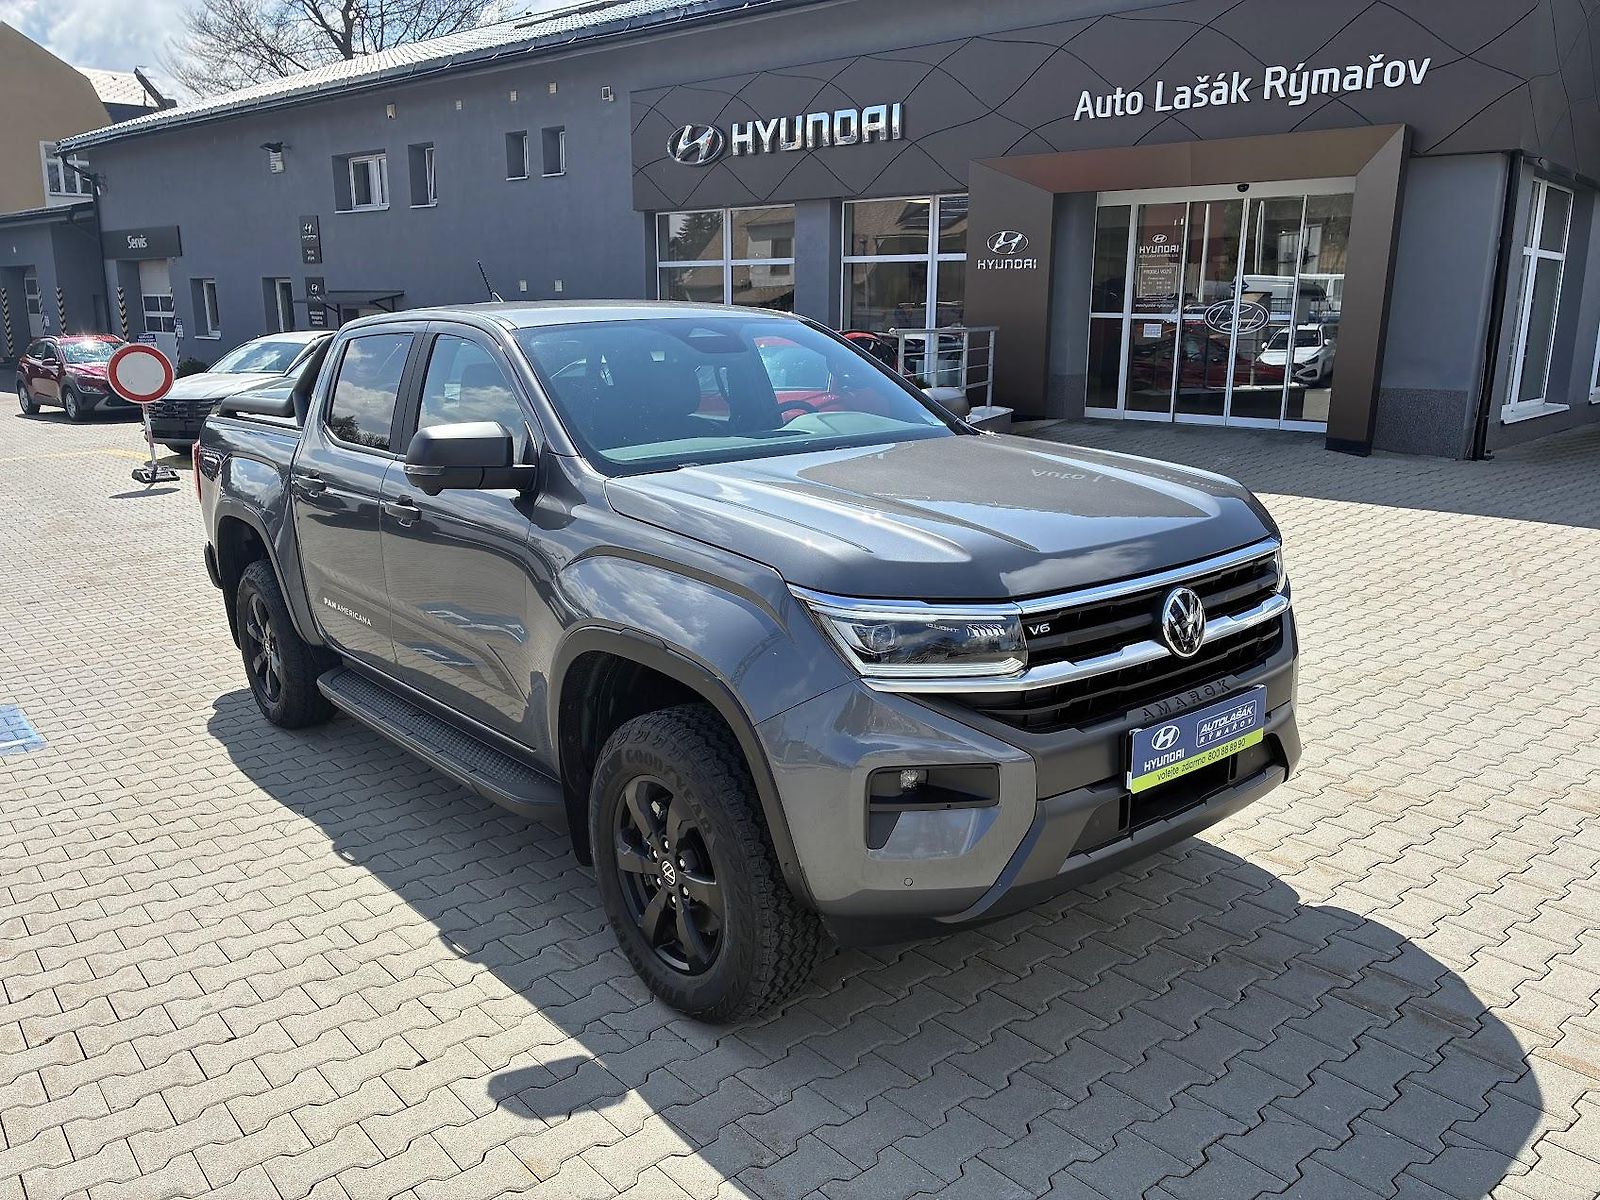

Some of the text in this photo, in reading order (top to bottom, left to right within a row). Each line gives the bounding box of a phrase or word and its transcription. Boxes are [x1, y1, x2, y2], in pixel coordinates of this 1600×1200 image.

[1074, 53, 1431, 121] Auto Lašák Rýmařov
[731, 102, 904, 156] HYUNDAI
[127, 234, 148, 249] Servis
[1139, 244, 1180, 254] HYUNDAI
[977, 258, 1037, 270] HYUNDAI
[1028, 623, 1051, 636] V6
[1142, 679, 1231, 721] AMAROK
[1143, 748, 1185, 772] HYUNDAI
[1156, 766, 1180, 781] volejte
[1181, 757, 1206, 772] zdarma
